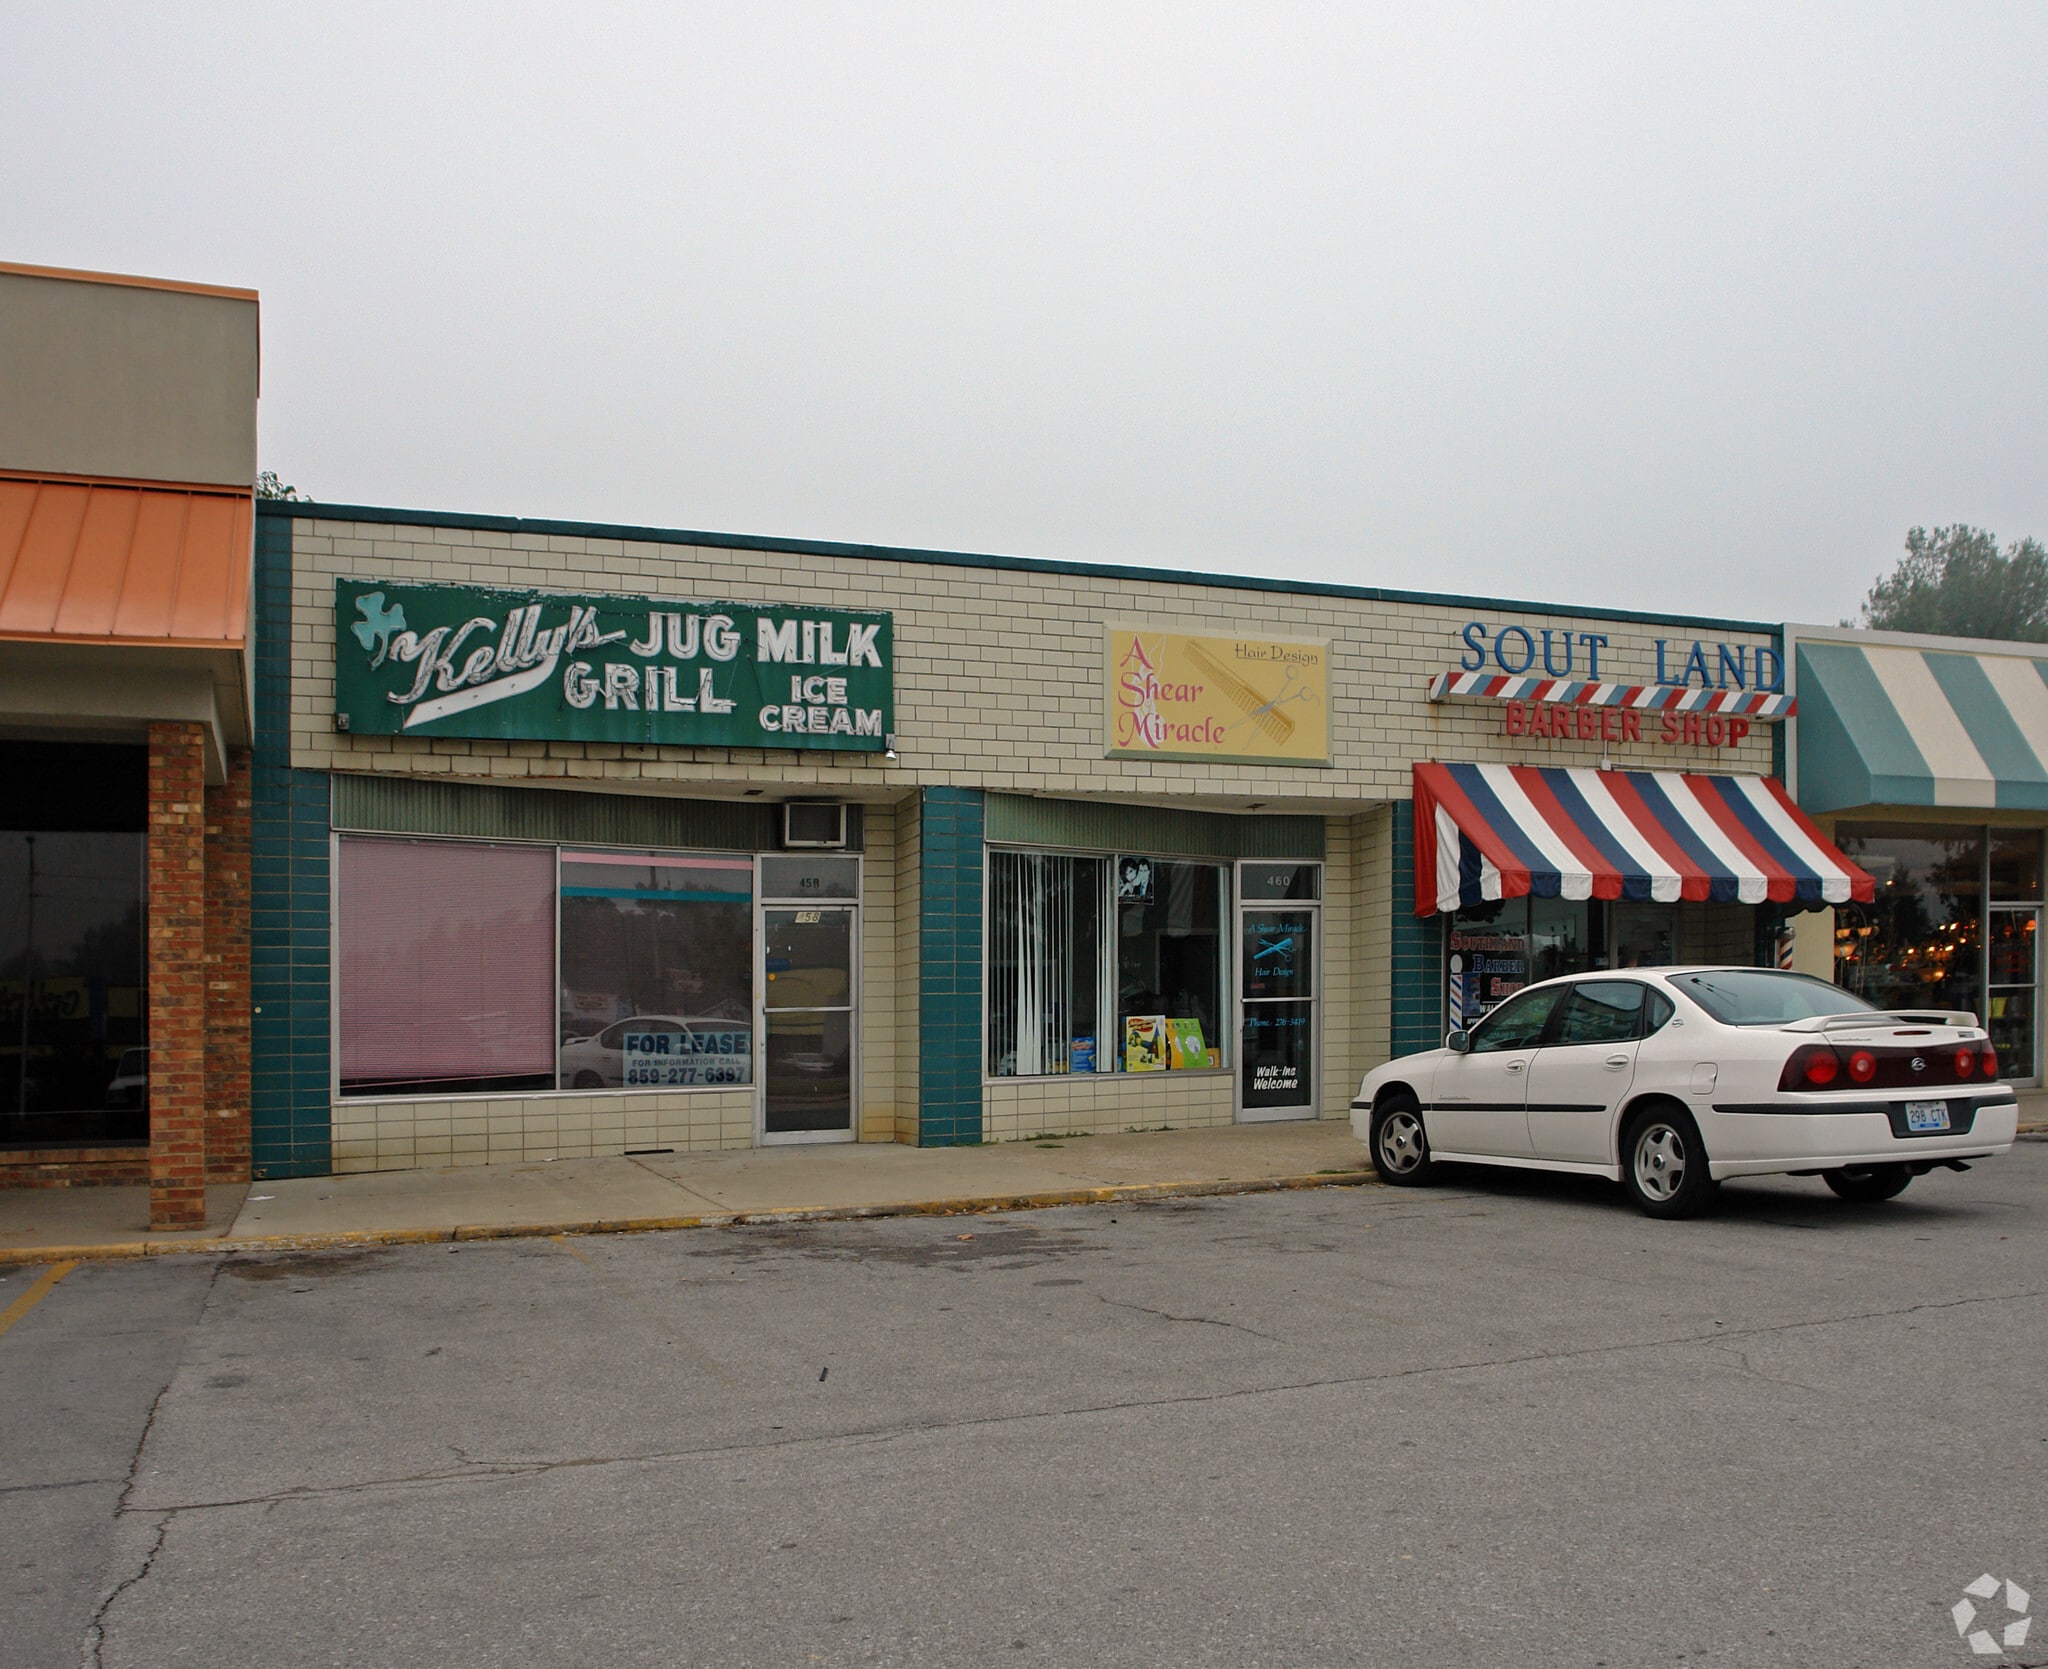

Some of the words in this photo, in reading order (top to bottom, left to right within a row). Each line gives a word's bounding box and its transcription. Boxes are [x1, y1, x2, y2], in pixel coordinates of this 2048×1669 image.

[630, 611, 741, 660] JUG
[757, 617, 882, 668] MILK
[1120, 634, 1153, 669] A
[1235, 643, 1267, 660] Hair
[1271, 645, 1319, 667] Design
[1461, 621, 1608, 681] SOUT
[1654, 640, 1785, 691] LAND
[388, 603, 627, 728] Kelly's
[565, 662, 736, 714] GRILL
[791, 675, 848, 705] ICE
[1118, 672, 1204, 708] Shear
[758, 704, 881, 737] CREAM
[1118, 711, 1225, 749] Miracle
[1506, 701, 1642, 742] BARBER
[1661, 711, 1749, 748] SHOP
[1266, 875, 1290, 887] 460
[627, 1035, 670, 1055] FOR
[680, 1034, 746, 1054] LEASE
[632, 1059, 651, 1067] FOR
[654, 1058, 715, 1066] INFORMATION
[719, 1057, 741, 1065] CALL
[1253, 1077, 1298, 1090] Welcome
